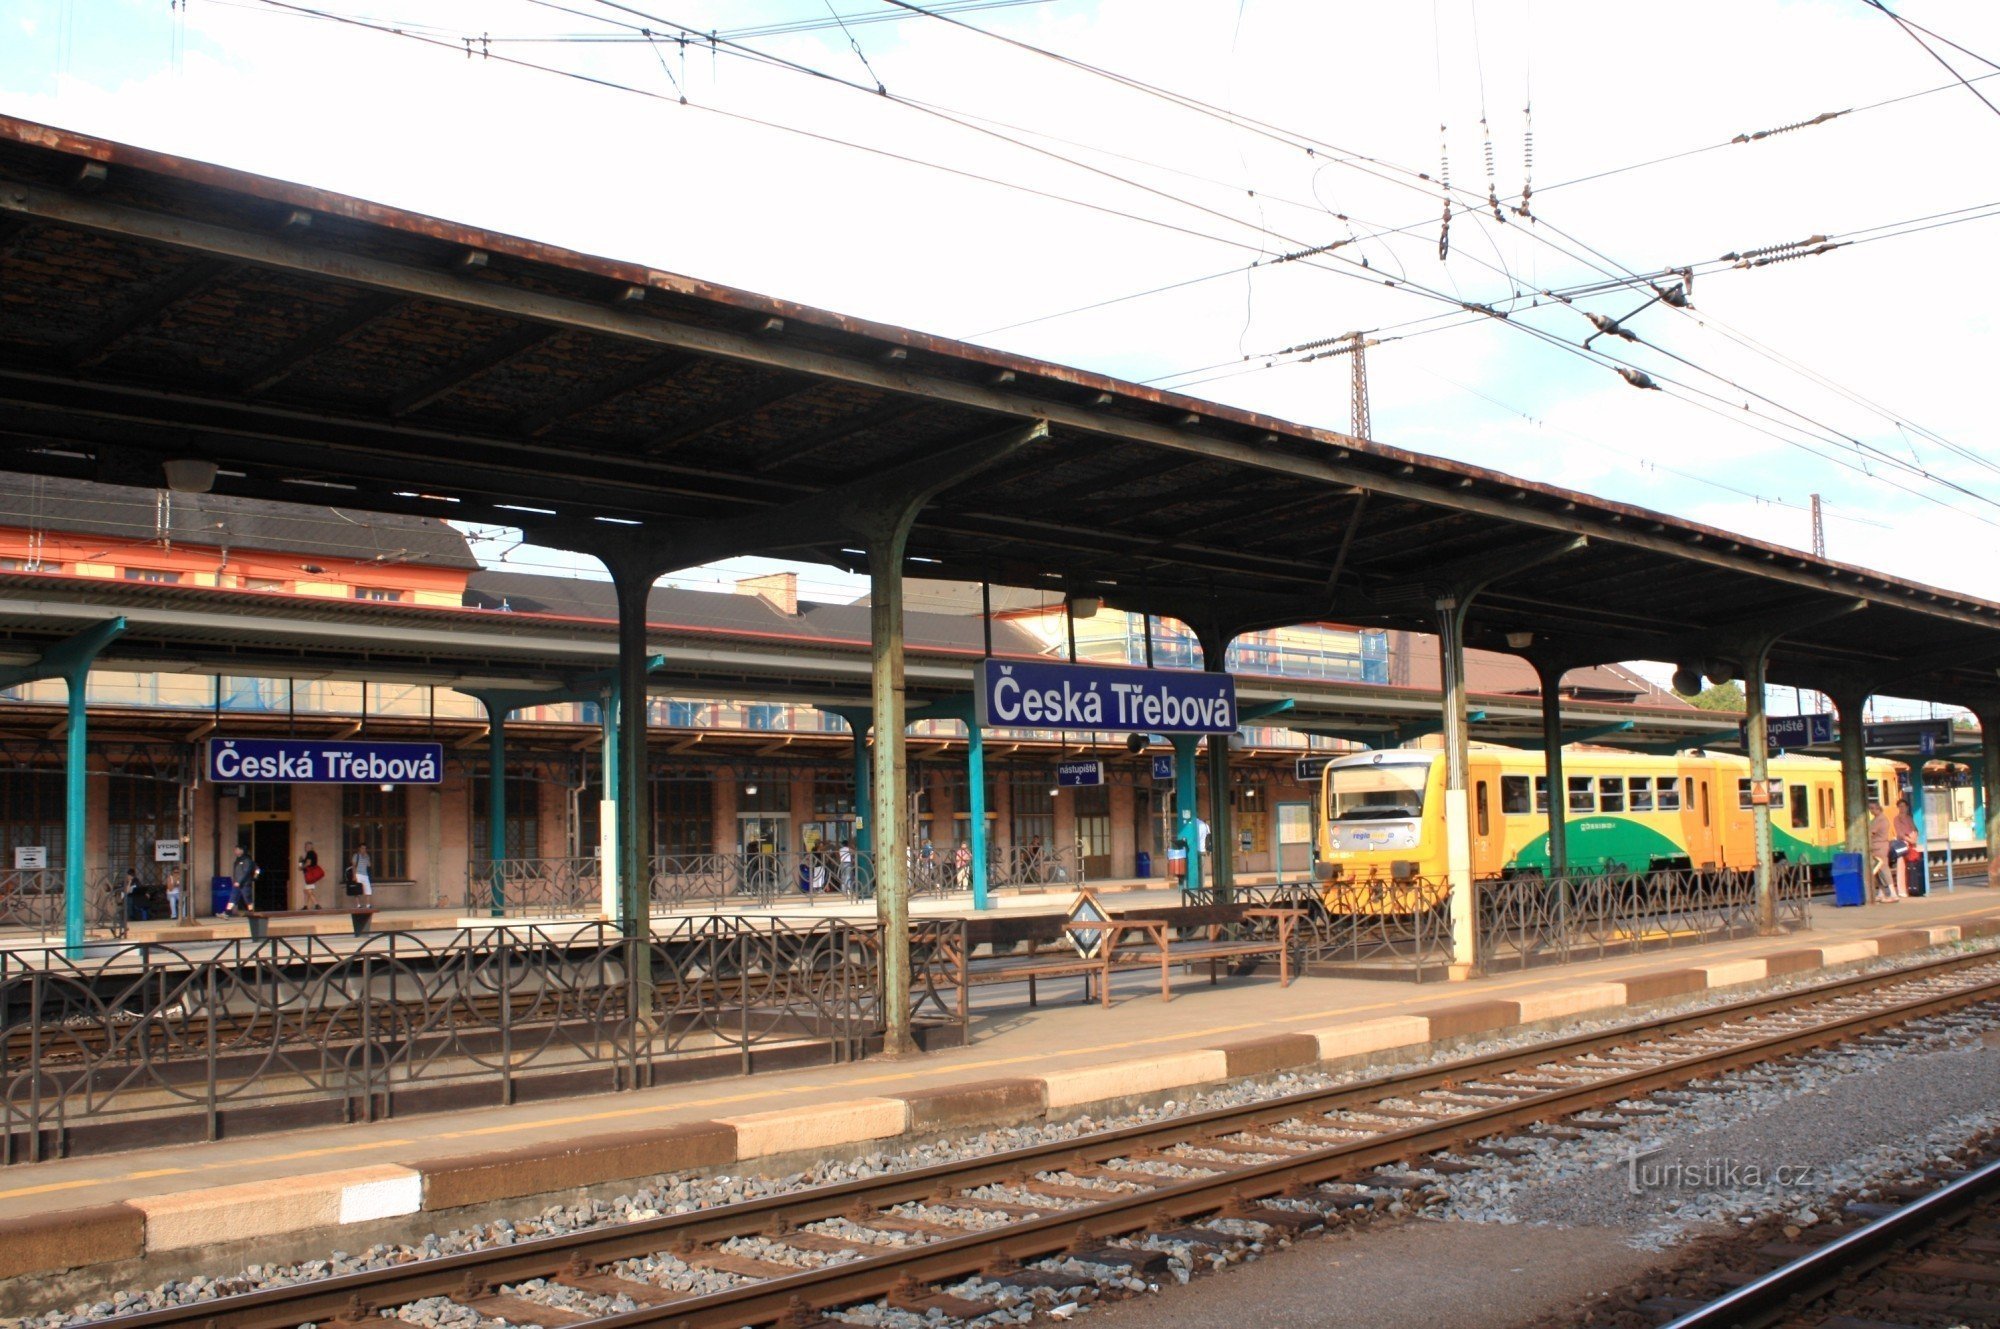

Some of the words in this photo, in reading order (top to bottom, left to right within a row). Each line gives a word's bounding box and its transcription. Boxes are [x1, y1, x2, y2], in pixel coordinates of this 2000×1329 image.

[994, 665, 1103, 724] Česká
[1110, 683, 1231, 728] Třebová
[1743, 720, 1804, 736] nupiště
[216, 740, 313, 778] Česká
[322, 751, 435, 780] Třebová
[1059, 763, 1097, 775] nástupiště
